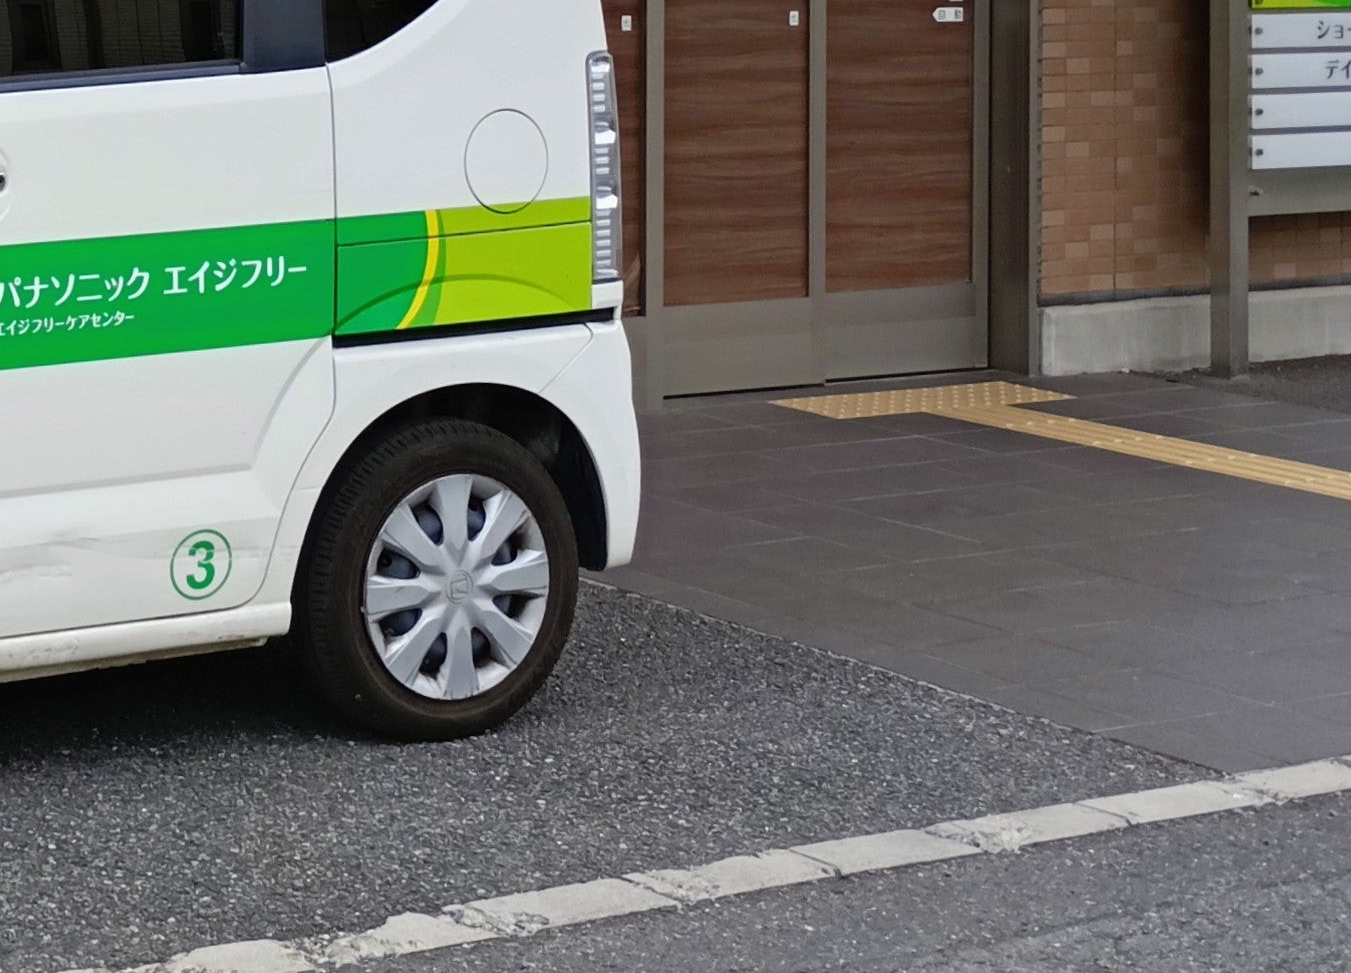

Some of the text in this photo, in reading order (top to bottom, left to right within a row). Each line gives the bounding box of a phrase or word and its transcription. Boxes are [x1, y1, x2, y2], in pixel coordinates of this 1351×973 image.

[1317, 20, 1351, 39] ショ
[163, 256, 307, 295] エイジフリー
[186, 540, 215, 590] 3
